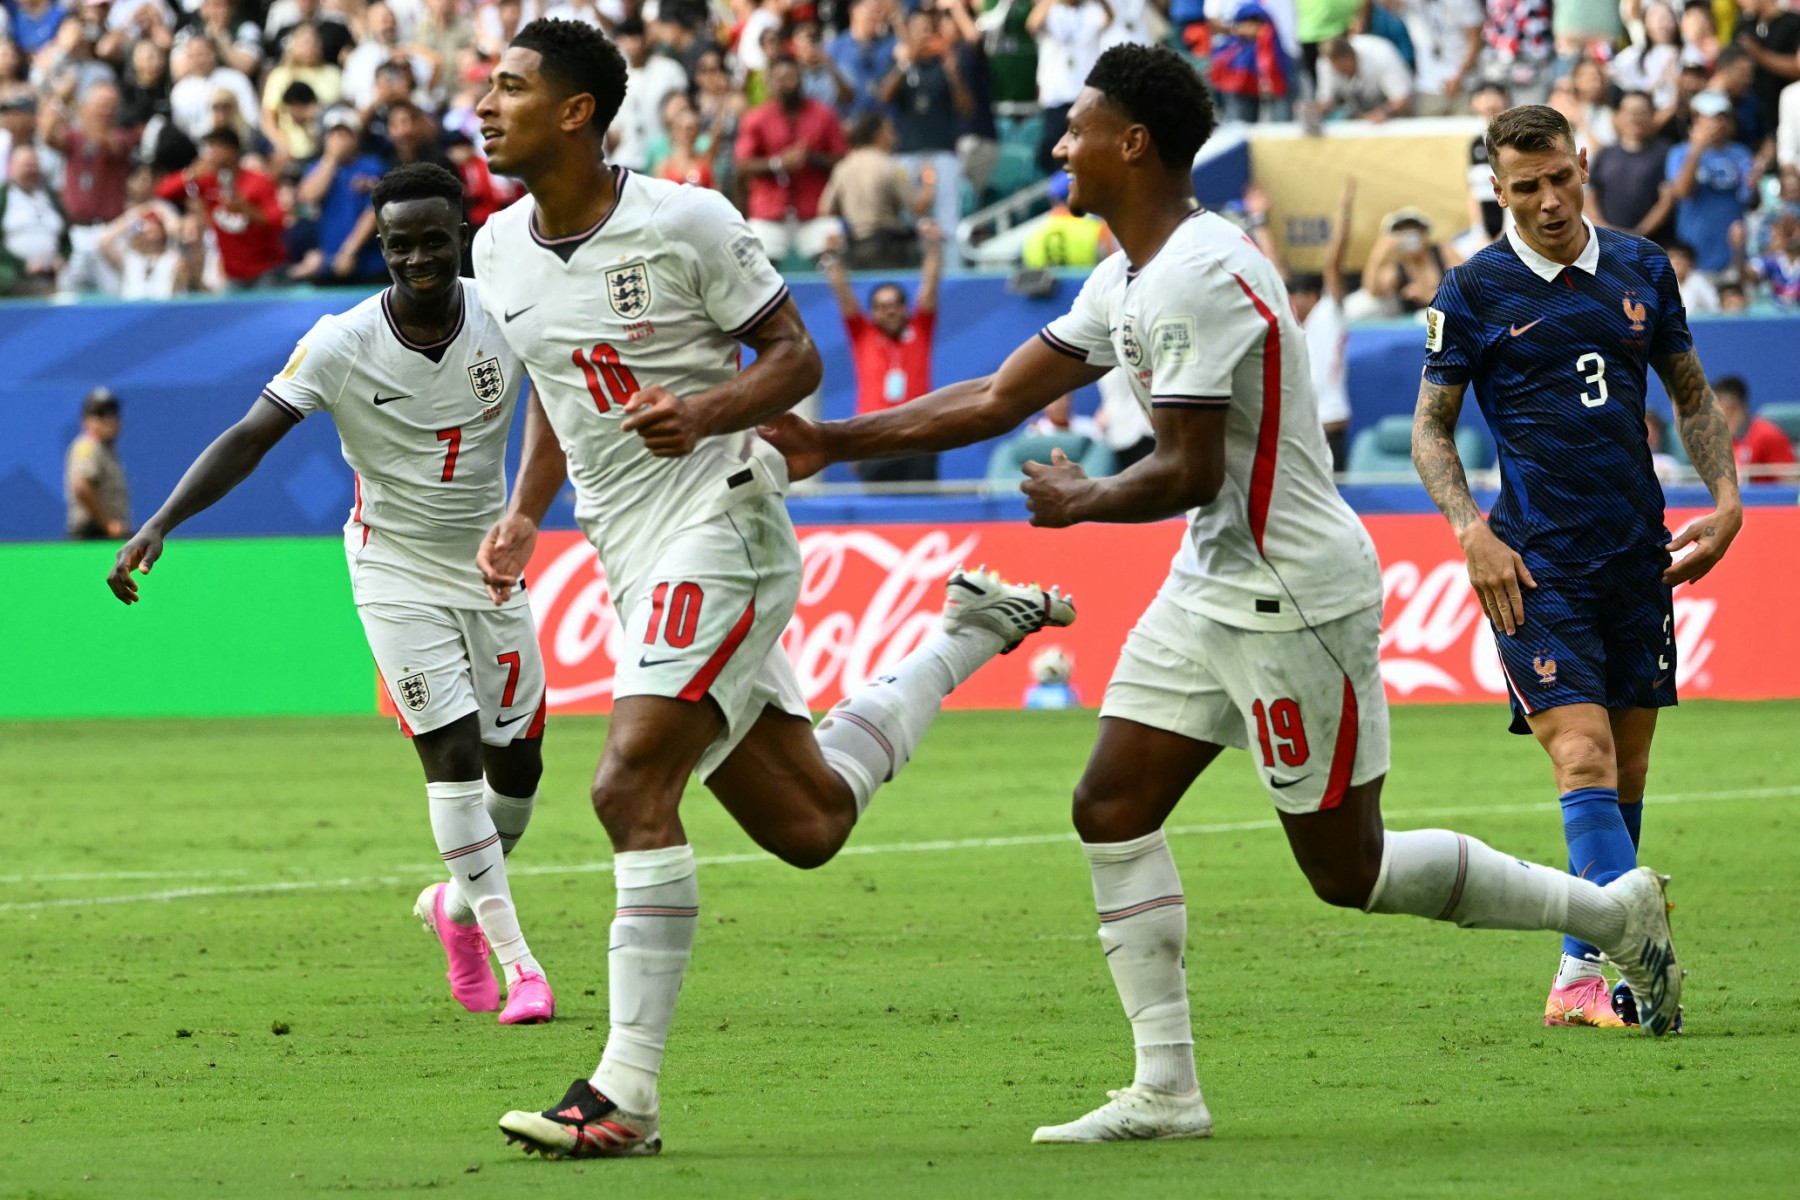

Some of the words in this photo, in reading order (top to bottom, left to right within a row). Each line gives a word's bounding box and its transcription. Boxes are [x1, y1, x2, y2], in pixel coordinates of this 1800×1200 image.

[1162, 330, 1189, 341] UNITES
[572, 342, 641, 414] 10
[1576, 352, 1608, 408] 3
[436, 427, 462, 482] 7
[643, 581, 704, 649] 10
[496, 650, 521, 708] 7
[1252, 697, 1310, 768] 19
